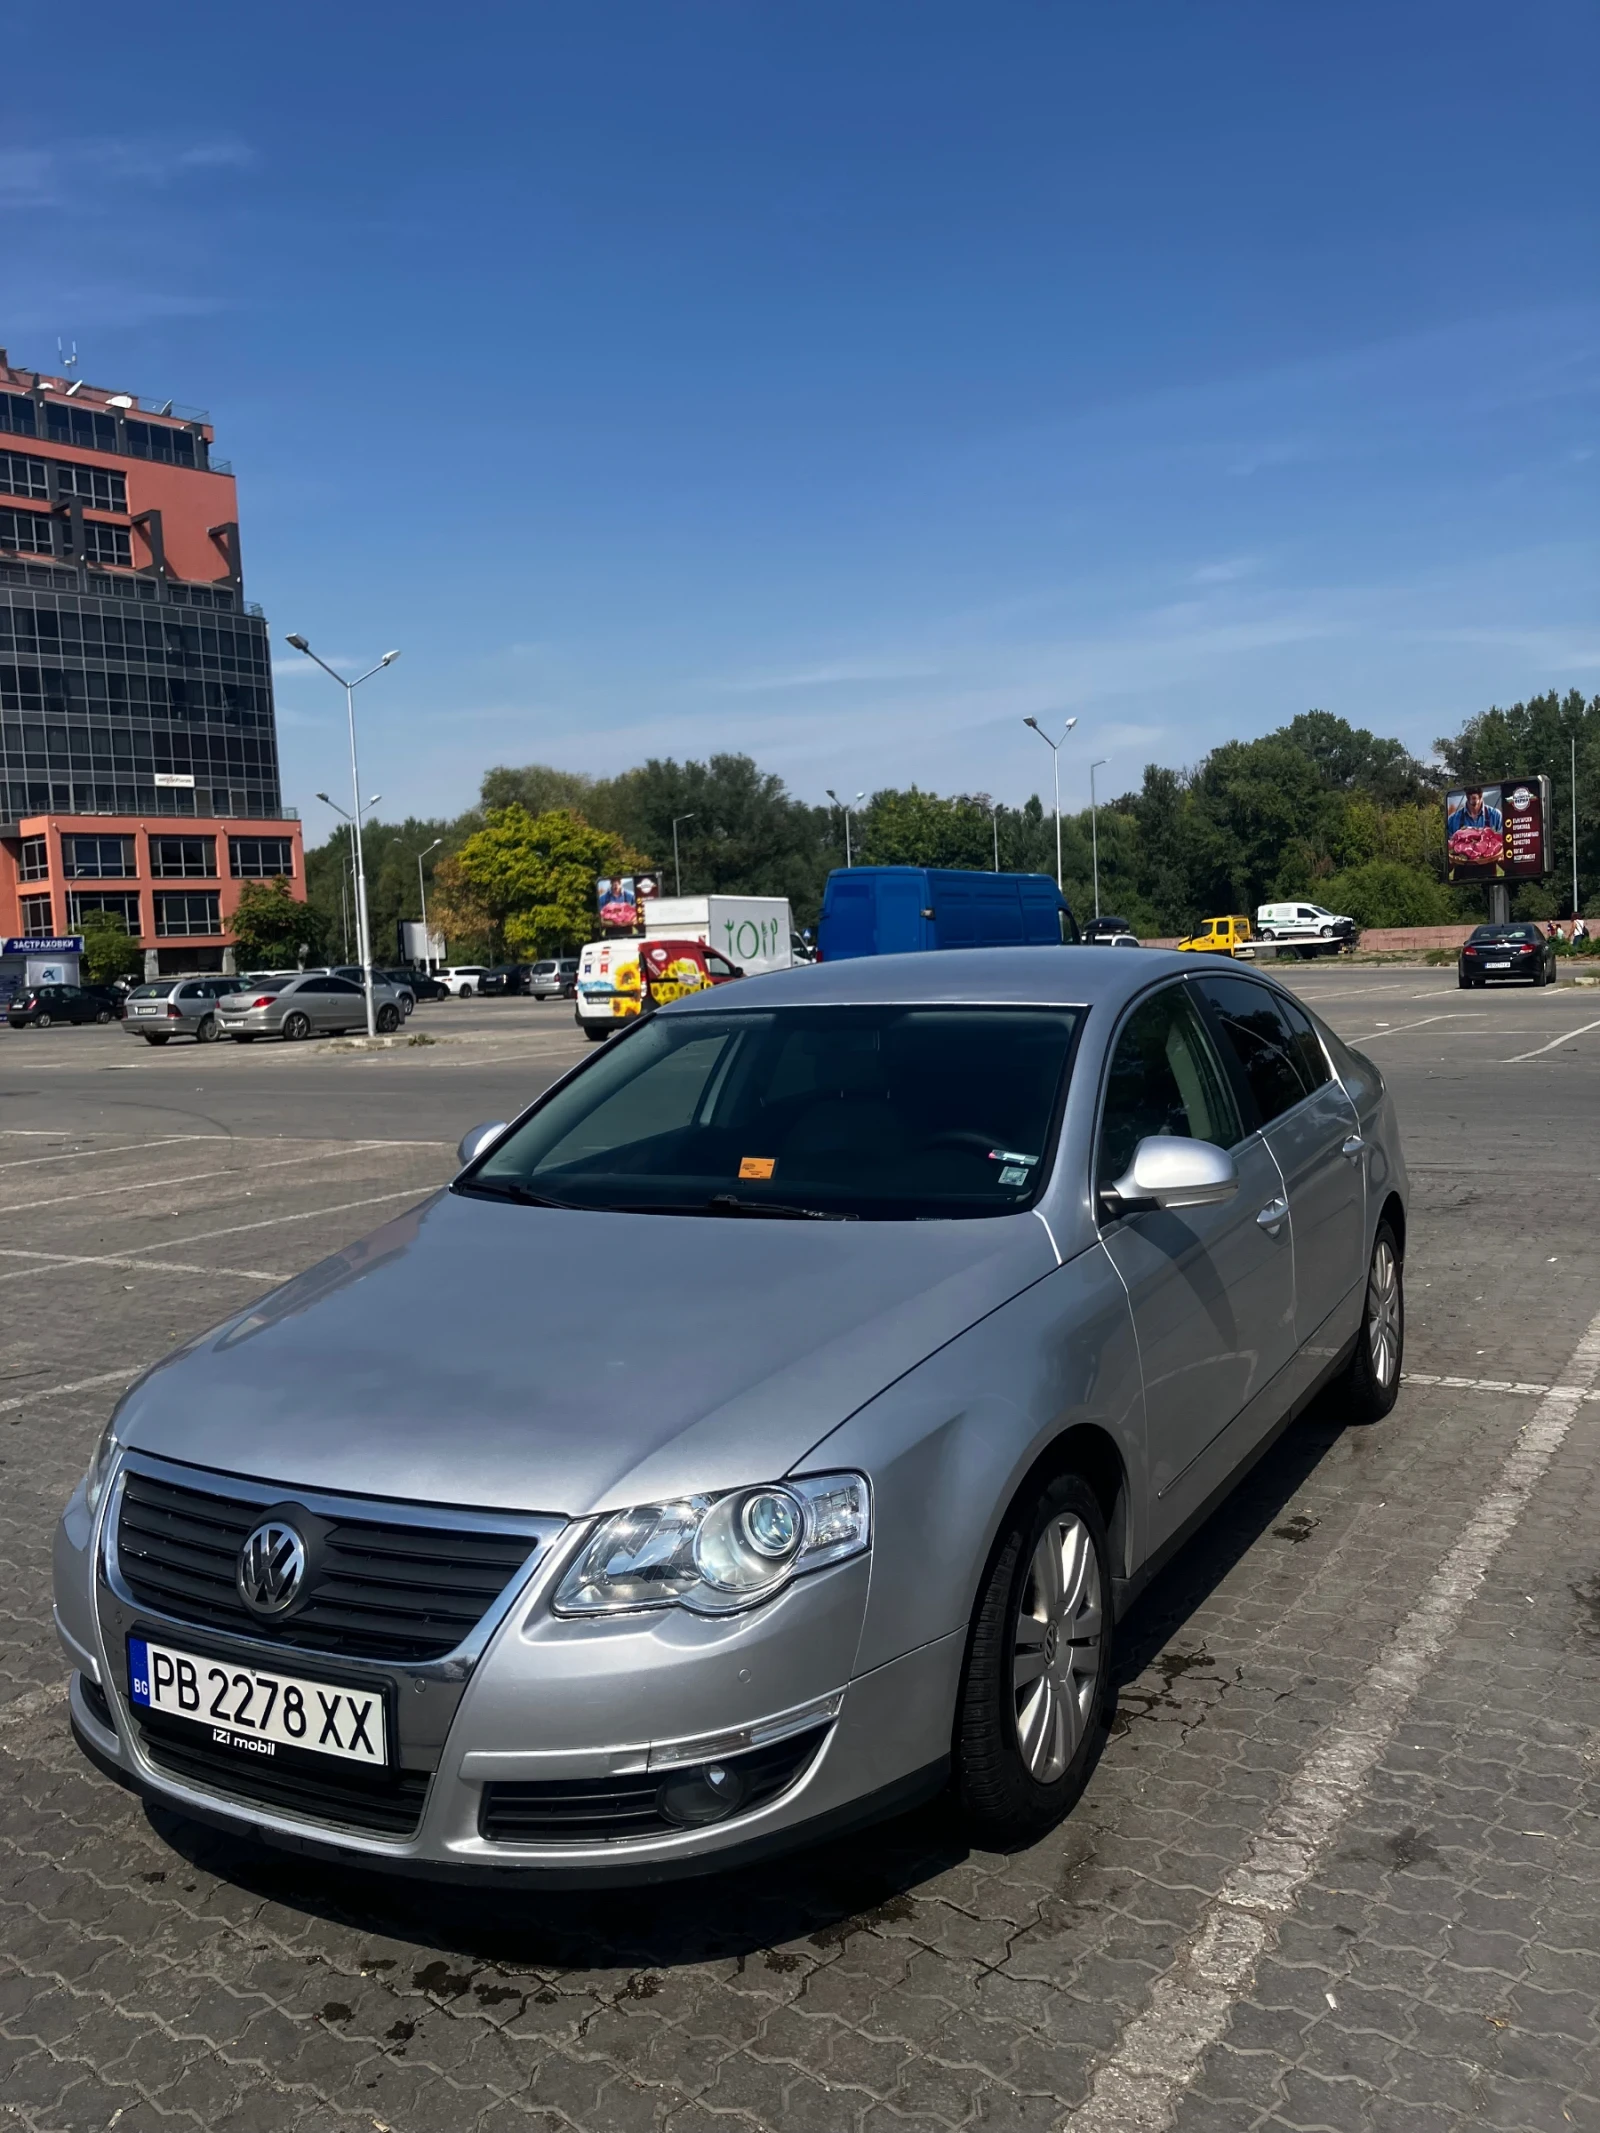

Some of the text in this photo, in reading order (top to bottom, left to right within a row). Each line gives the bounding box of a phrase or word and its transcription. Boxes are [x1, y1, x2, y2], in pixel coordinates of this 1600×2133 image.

[13, 939, 74, 949] ЗАСТРАХОВКИ
[134, 1677, 148, 1696] BG
[152, 1651, 375, 1755] PB 2278 XX
[233, 1736, 275, 1756] mobil
